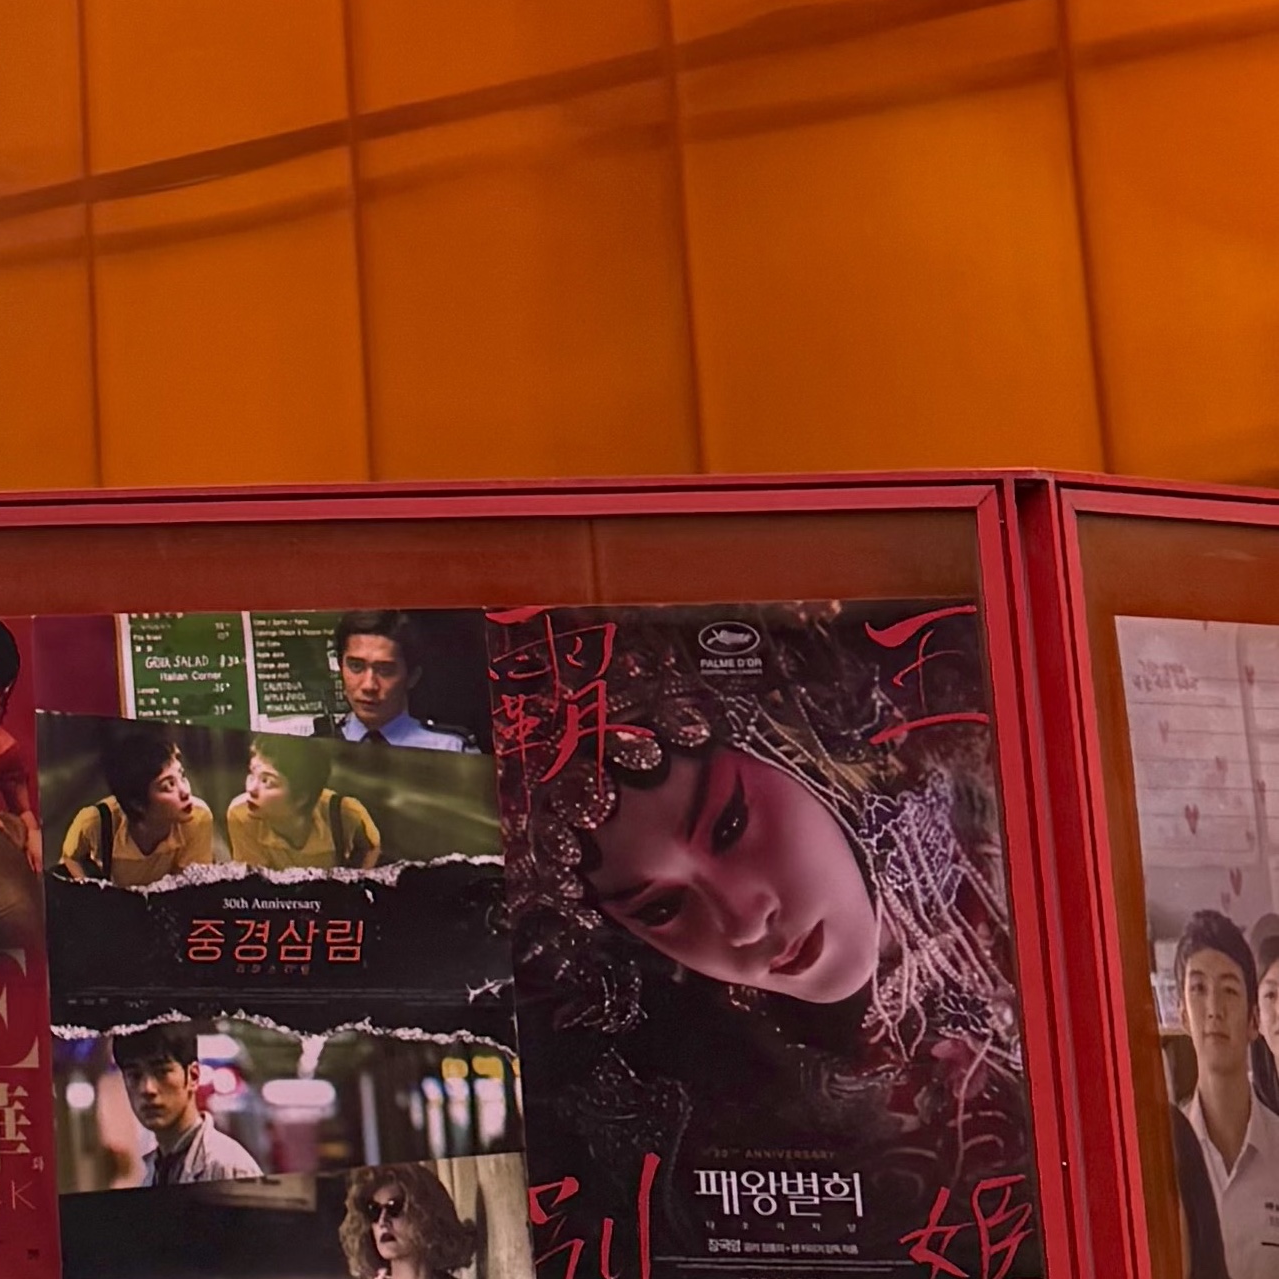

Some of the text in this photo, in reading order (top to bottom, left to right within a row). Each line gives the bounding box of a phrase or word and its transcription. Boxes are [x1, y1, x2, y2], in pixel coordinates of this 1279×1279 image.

[221, 896, 323, 913] 30th Anniversary
[186, 919, 366, 963] 중경삼림
[693, 1170, 863, 1218] 패왕별희
